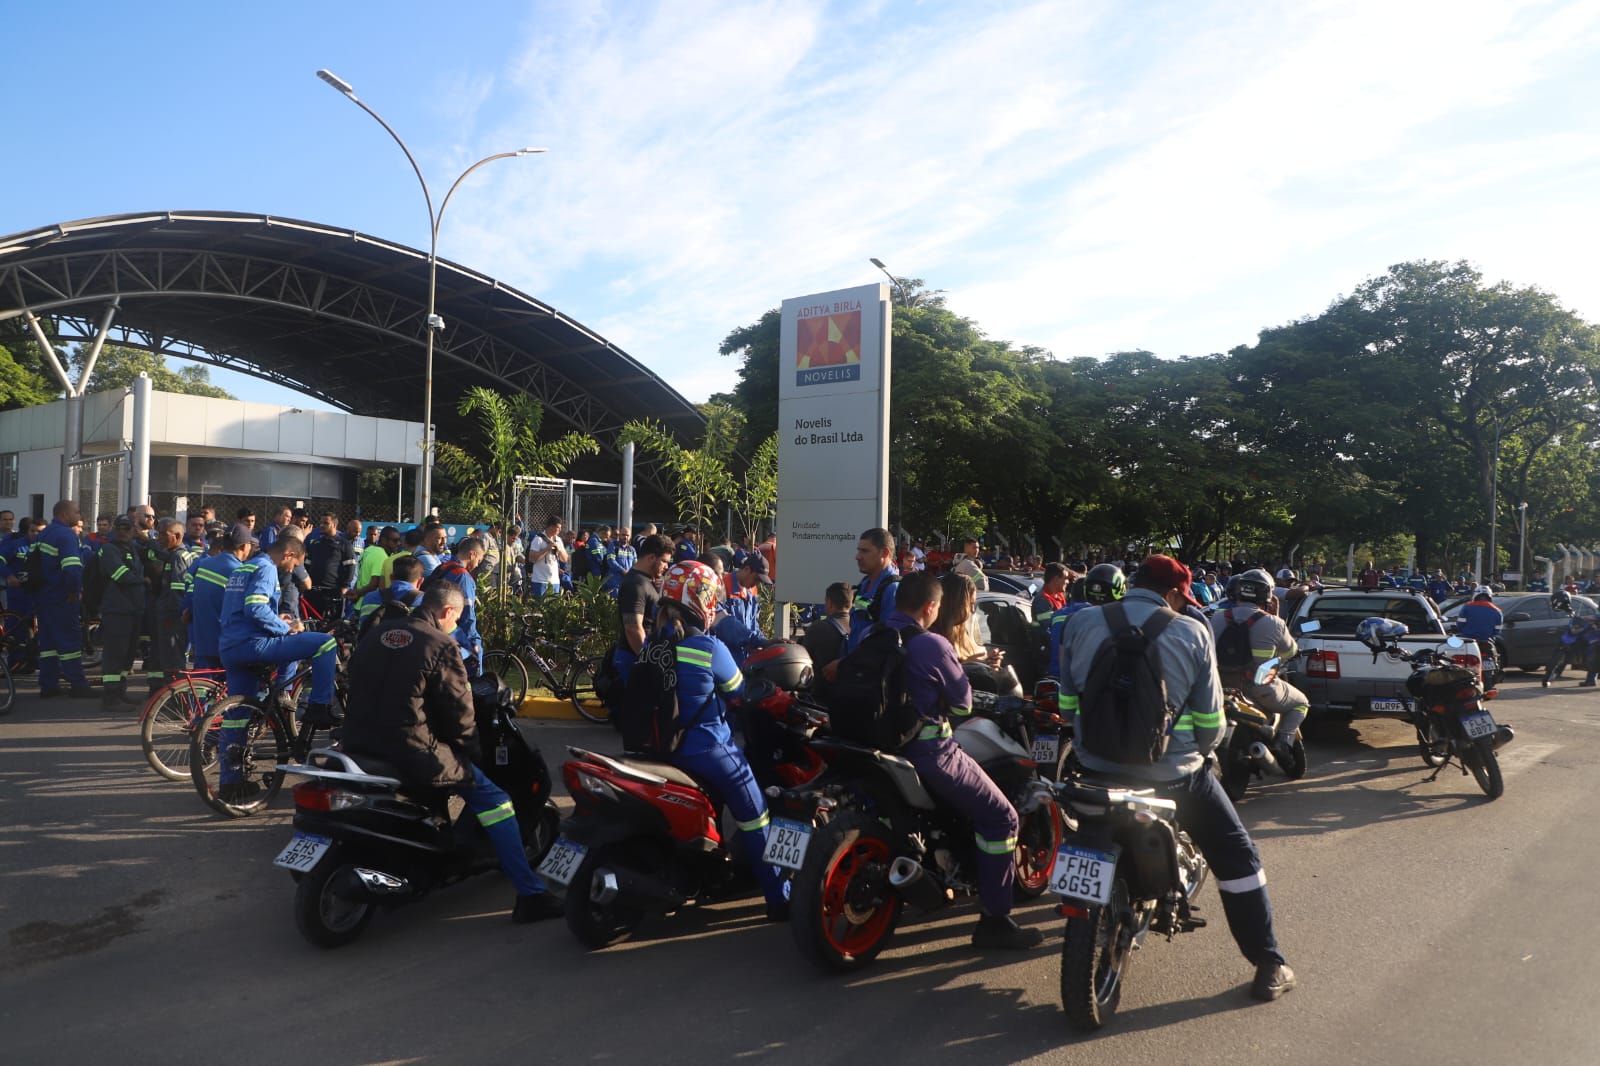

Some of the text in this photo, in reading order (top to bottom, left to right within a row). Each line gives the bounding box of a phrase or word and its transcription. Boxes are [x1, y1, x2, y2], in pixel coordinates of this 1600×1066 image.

[797, 300, 862, 318] ADITYA BIRLA
[804, 368, 852, 383] NOVELIS
[795, 417, 832, 430] Novelis
[794, 431, 864, 446] do Brasil Ltda
[792, 521, 820, 529] Unidade
[792, 531, 856, 542] Pindamonhangaba
[776, 829, 801, 847] BZV
[292, 839, 319, 856] EHS
[555, 847, 577, 865] GFJ
[770, 843, 800, 865] 8A40
[280, 851, 314, 868] 3B77
[1066, 857, 1101, 878] FHG
[1058, 873, 1102, 899] 6G51
